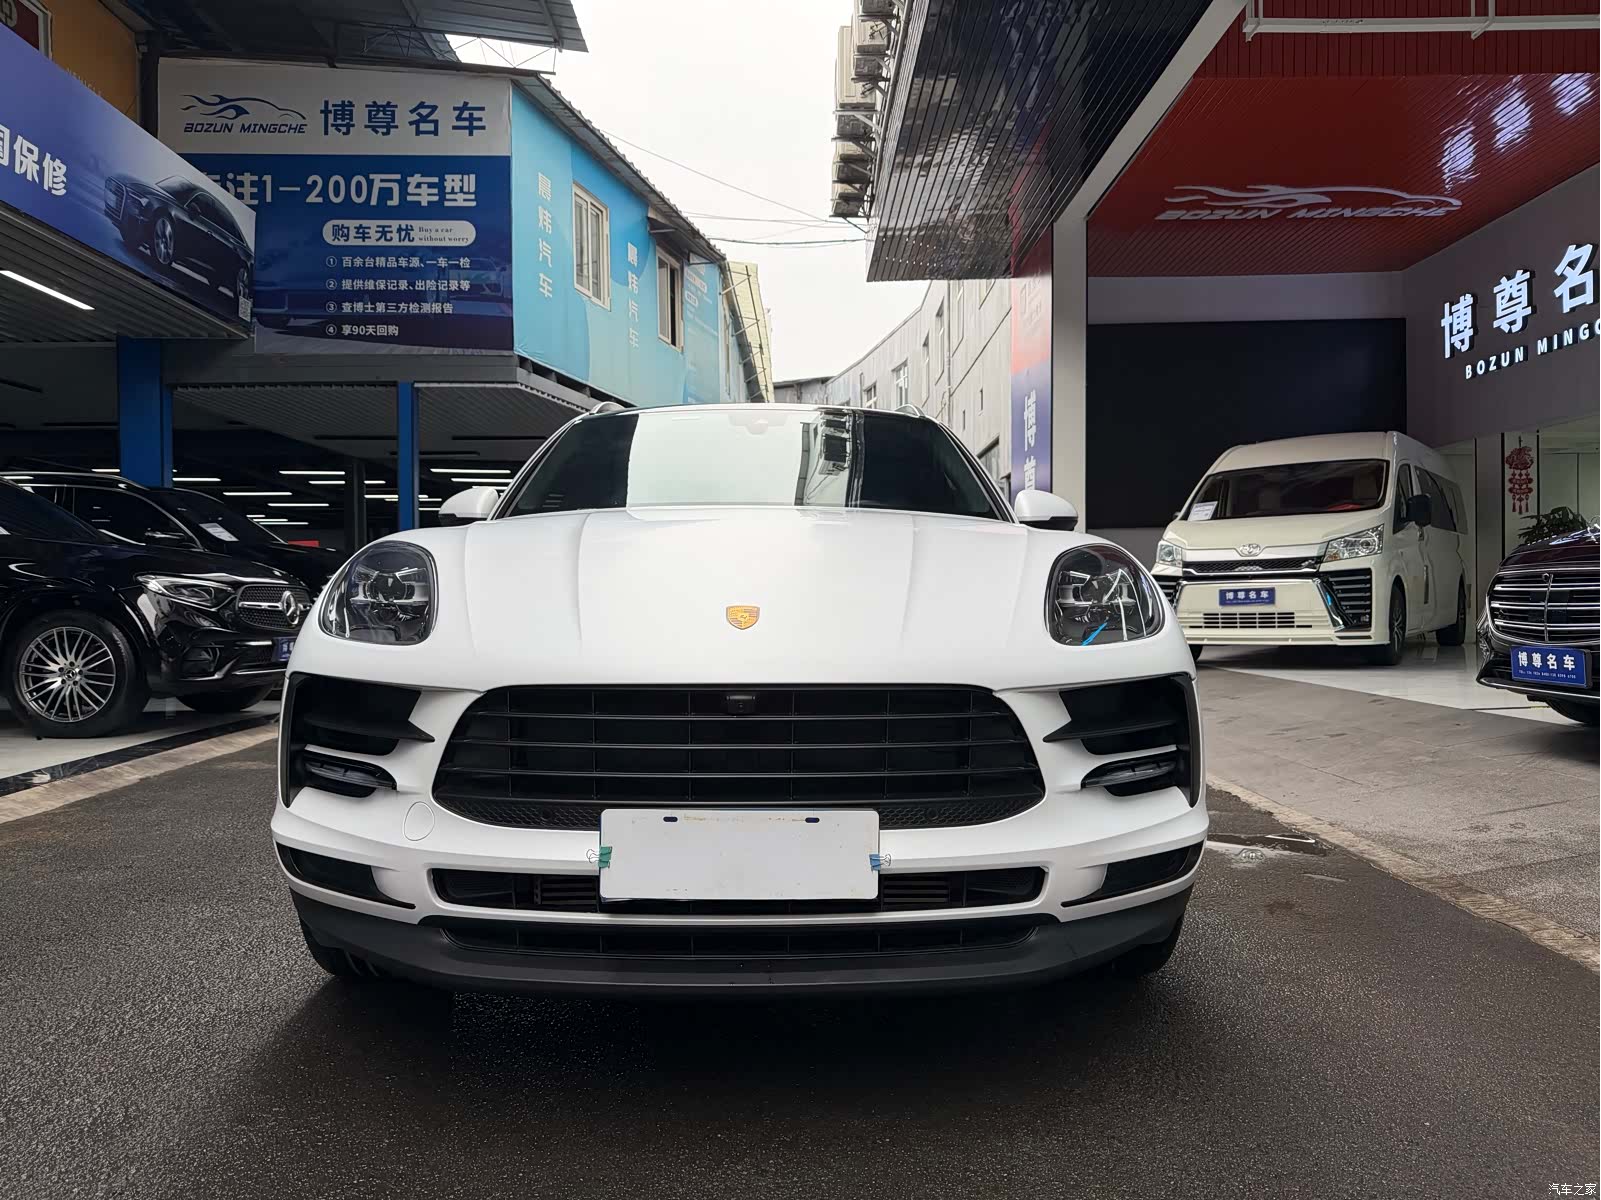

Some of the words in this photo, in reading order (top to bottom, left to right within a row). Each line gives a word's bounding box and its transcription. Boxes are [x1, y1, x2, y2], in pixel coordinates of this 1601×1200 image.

[320, 100, 486, 137] 博尊名车
[183, 123, 233, 133] BOZUN
[239, 123, 307, 134] MINGCHE
[202, 172, 477, 207] 注1-200万车型
[1155, 208, 1283, 221] BOZUN
[1286, 206, 1457, 220] MINGCHE
[331, 224, 415, 243] 购车无忧
[418, 226, 433, 234] Buy
[538, 172, 553, 298] 晨炜汽车
[448, 236, 470, 244] worry
[341, 302, 453, 314] 查博士第三方检测报告
[1441, 244, 1593, 359] 博尊名
[341, 324, 399, 337] 享90天回购
[1465, 346, 1524, 380] BOZUN
[1518, 651, 1576, 671] 博尊名车
